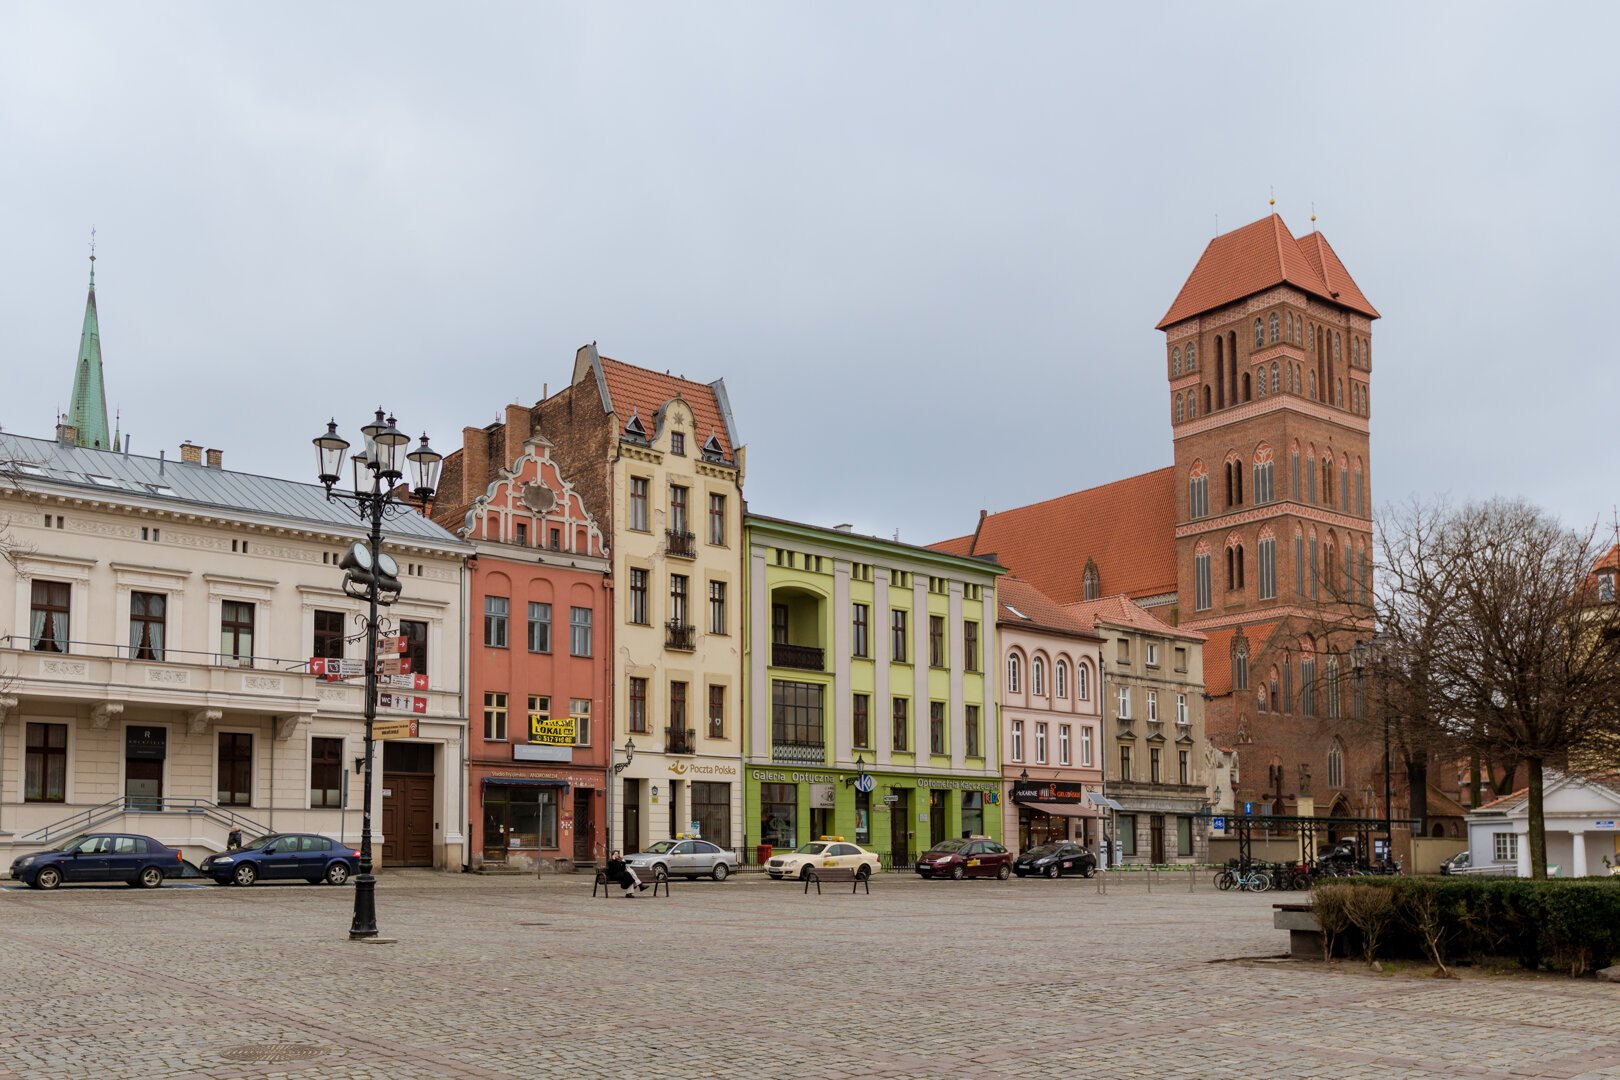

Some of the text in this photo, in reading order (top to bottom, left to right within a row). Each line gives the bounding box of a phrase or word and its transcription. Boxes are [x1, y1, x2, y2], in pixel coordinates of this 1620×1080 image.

[535, 726, 562, 735] LOKAL
[690, 764, 736, 775] Poczta Polska
[752, 769, 834, 784] Galeria Optyczna
[917, 778, 1000, 791] Optometria Karczewski
